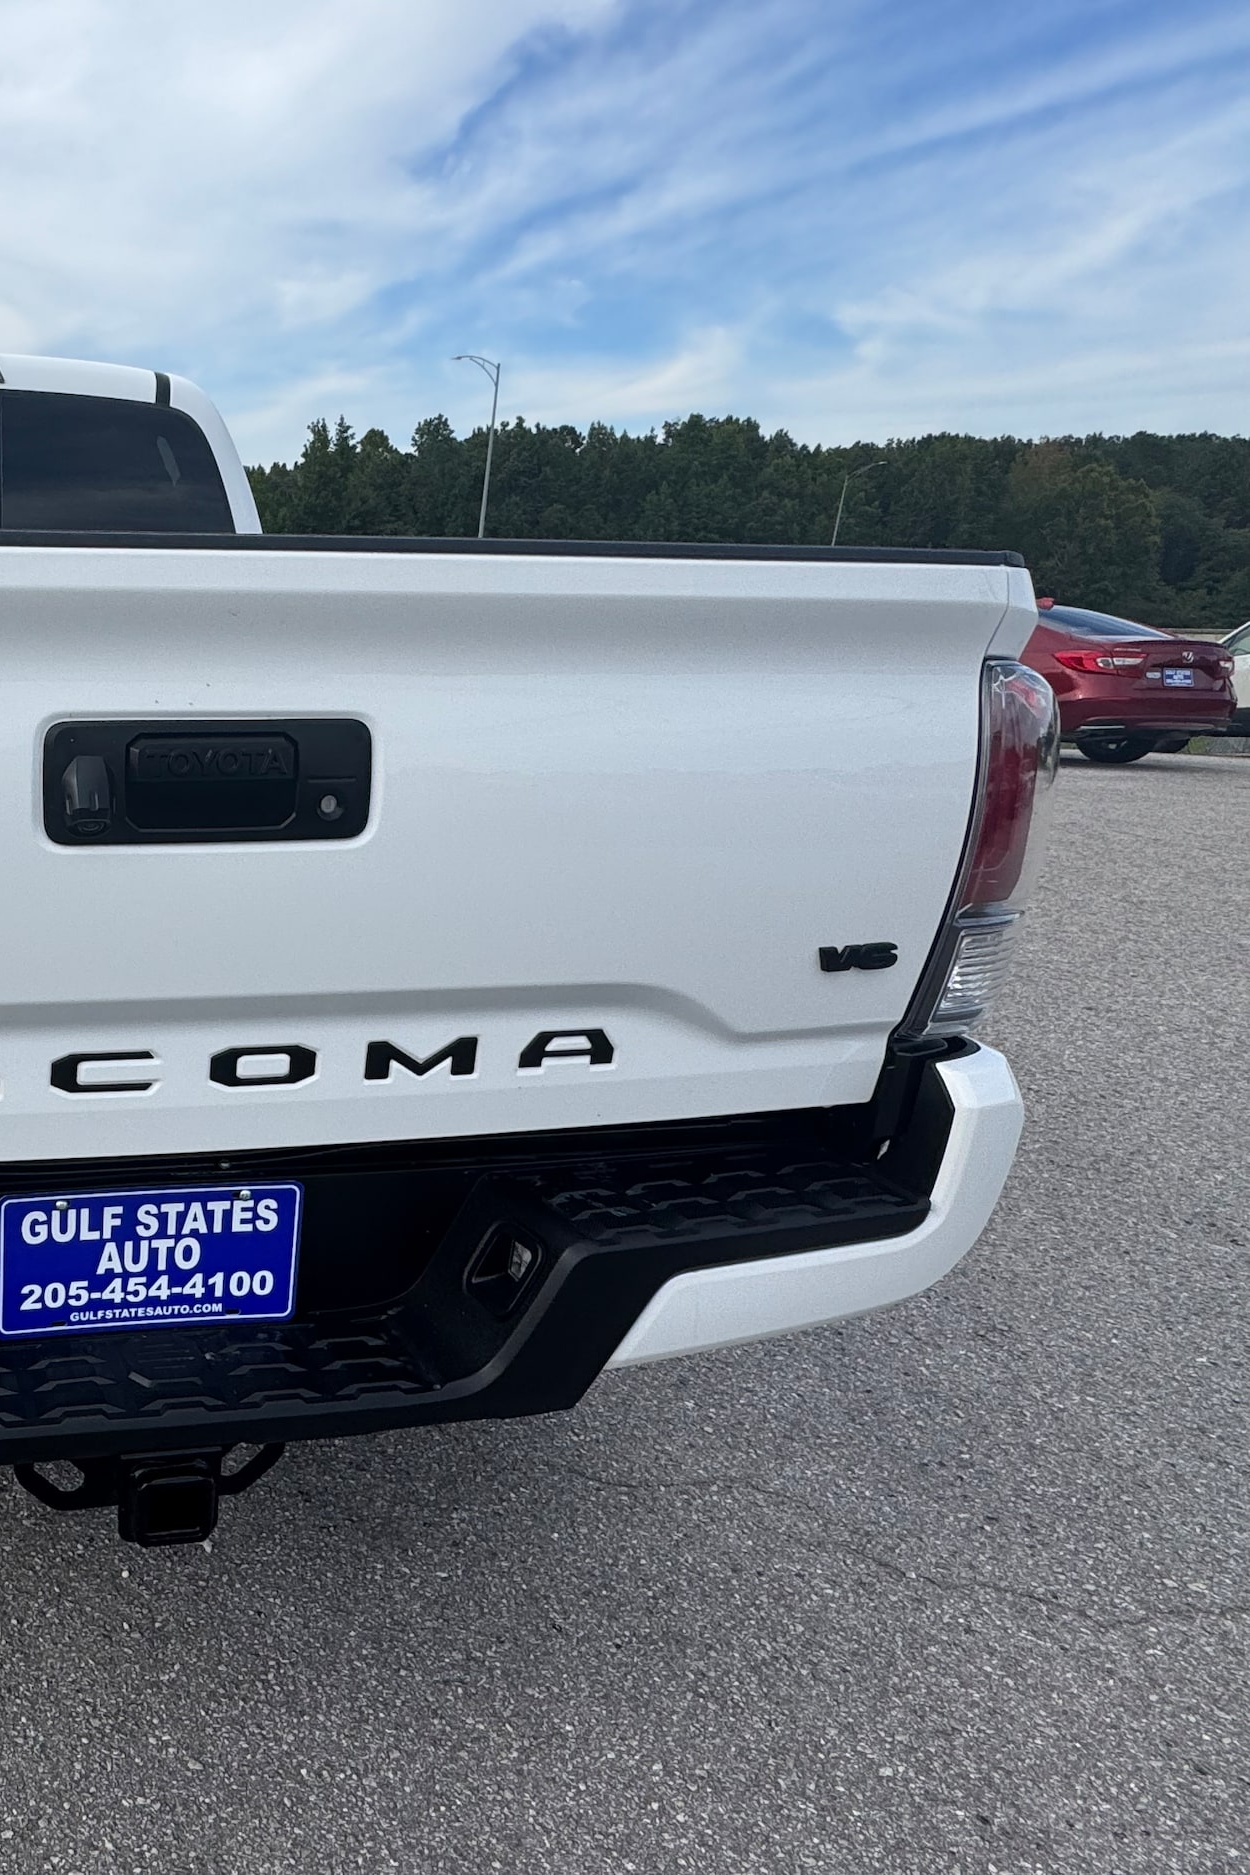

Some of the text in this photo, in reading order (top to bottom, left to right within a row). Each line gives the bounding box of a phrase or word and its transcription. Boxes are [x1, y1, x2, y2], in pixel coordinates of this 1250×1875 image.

[143, 748, 288, 777] TOYOTA
[819, 942, 899, 972] V6
[21, 1198, 279, 1245] GULF STATES
[96, 1237, 201, 1275] AUTO
[20, 1270, 274, 1311] 205-454-4100
[70, 1303, 223, 1322] GULFSTATESAUTO.COM
